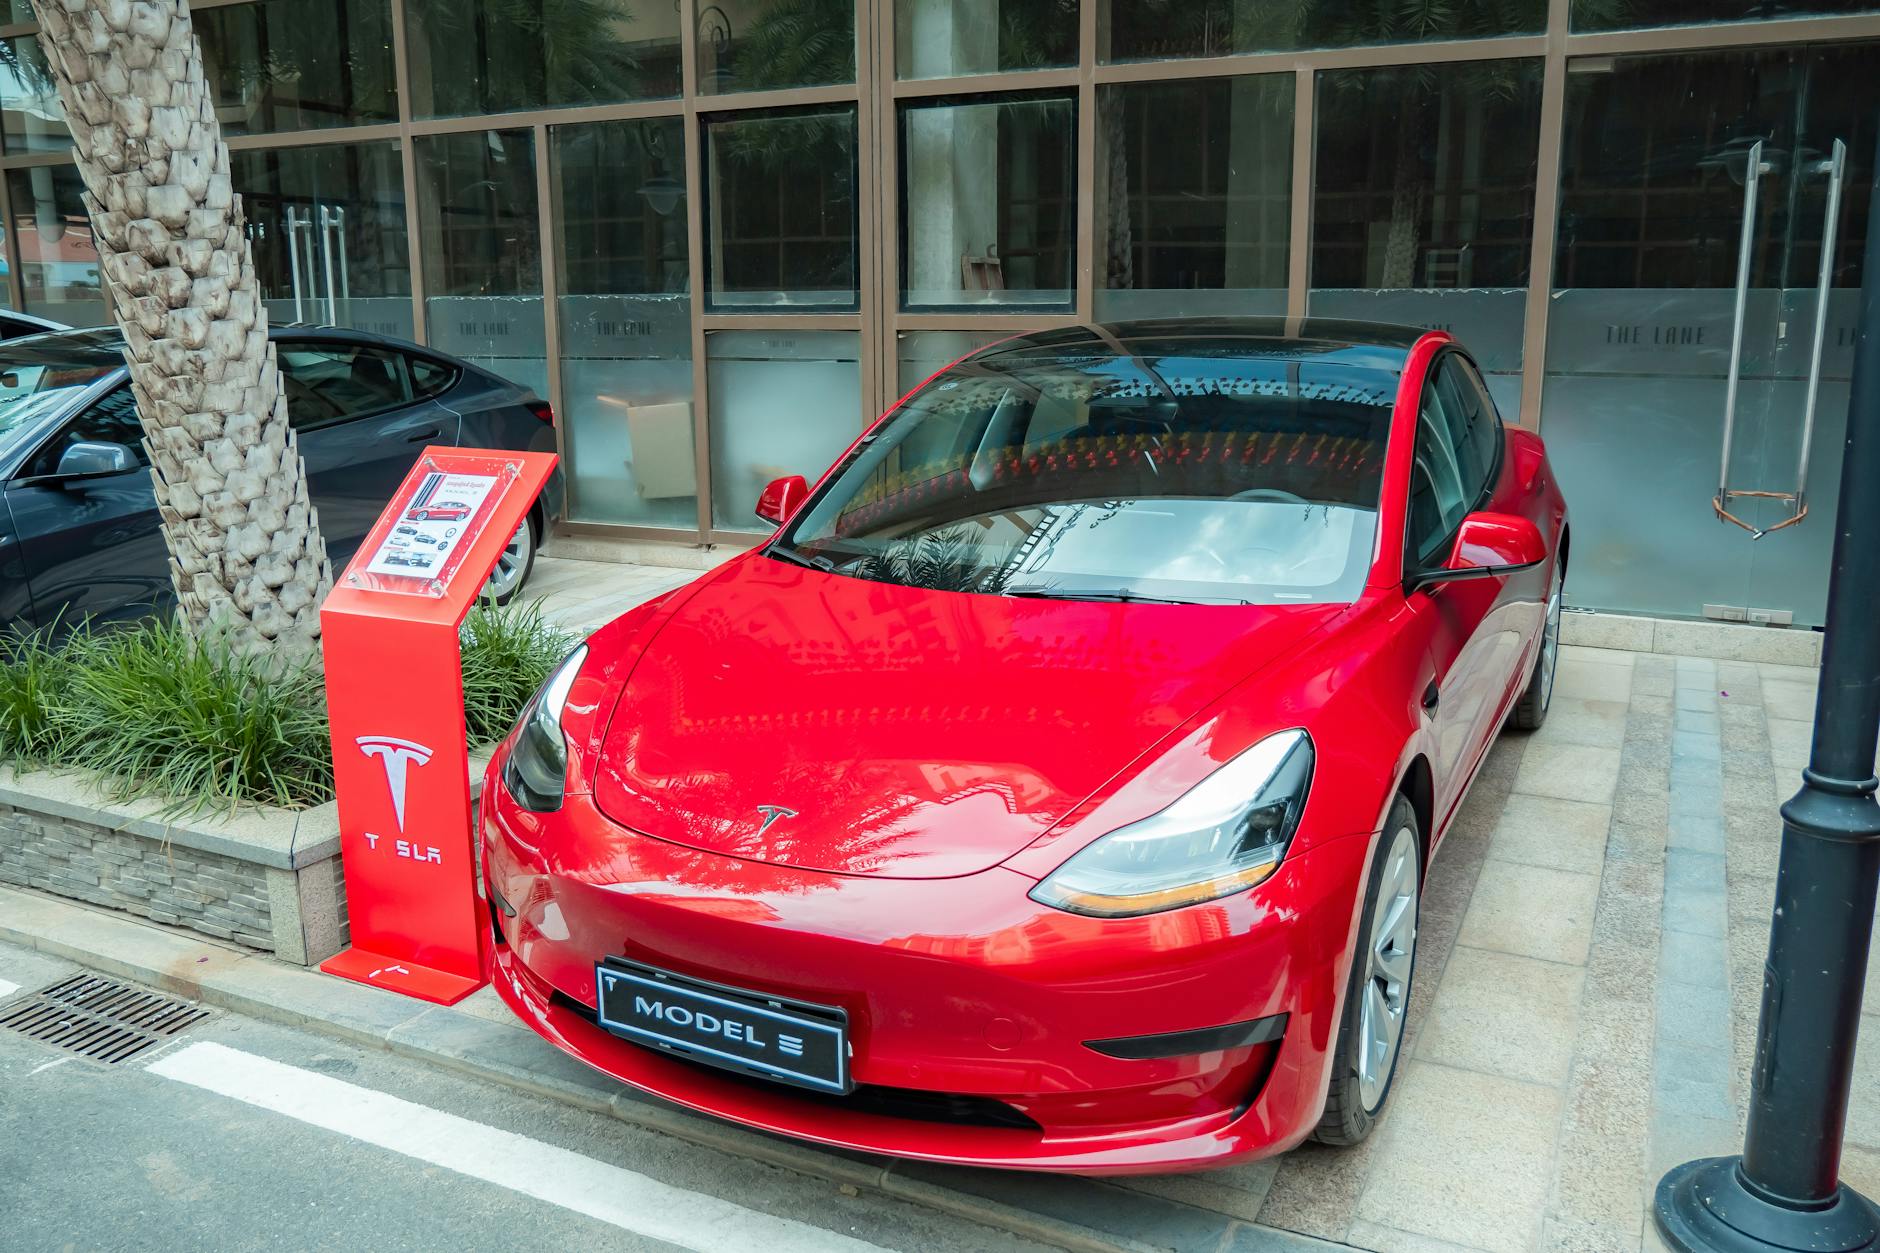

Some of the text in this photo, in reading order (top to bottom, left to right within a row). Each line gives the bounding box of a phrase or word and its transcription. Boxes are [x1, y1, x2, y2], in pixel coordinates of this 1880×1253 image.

[1606, 325, 1705, 346] THE LANE
[635, 995, 766, 1047] MODEL
